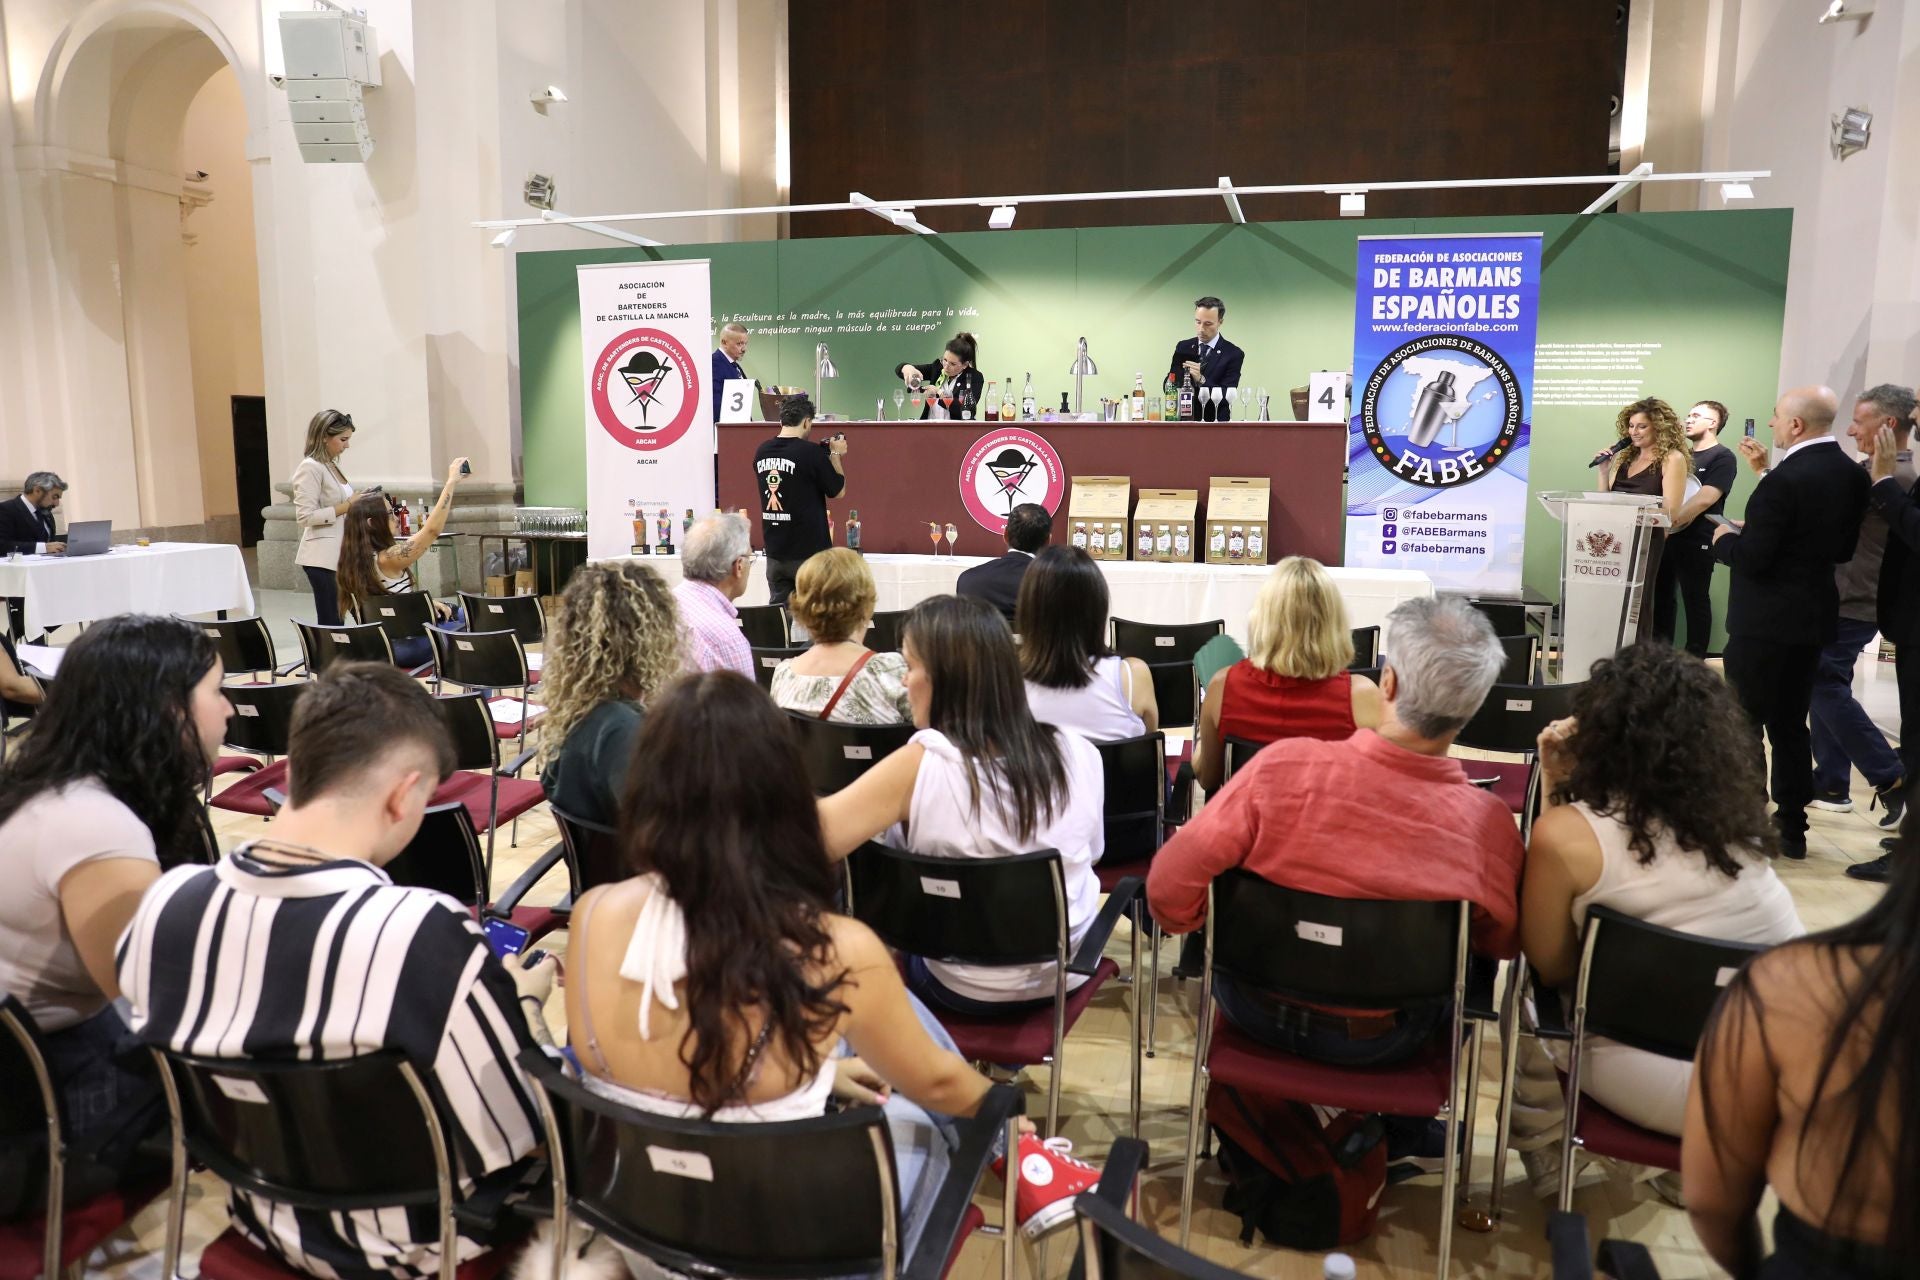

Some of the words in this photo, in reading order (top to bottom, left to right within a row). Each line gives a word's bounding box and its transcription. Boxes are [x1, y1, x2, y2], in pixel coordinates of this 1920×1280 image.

[1375, 251, 1433, 264] FEDERACIÓN
[1437, 253, 1449, 262] DE
[1452, 252, 1522, 262] ASOCIACIONES
[1373, 268, 1400, 288] DE
[1409, 267, 1522, 288] BARMANS
[618, 281, 665, 290] ASOCIACIÓN
[618, 302, 668, 310] BARTENDERS
[1372, 289, 1520, 320] ESPAÑOLES
[722, 314, 729, 322] la
[732, 313, 772, 322] Escultura
[790, 312, 797, 320] la
[801, 310, 830, 321] madre,
[836, 310, 844, 319] la
[848, 310, 865, 319] más
[870, 308, 917, 320] equilibrada
[922, 310, 942, 319] para
[946, 307, 954, 316] la
[758, 324, 800, 336] anquilosar
[837, 322, 872, 332] músculo
[876, 322, 887, 332] de
[1372, 322, 1519, 332] www.federacionfabe.com
[1365, 375, 1382, 434] FEDERACIÓN
[1378, 362, 1391, 376] DE
[1390, 338, 1458, 365] ASOCIACIONES
[1460, 340, 1473, 350] DE
[1473, 345, 1510, 382] BARMANS
[1505, 382, 1519, 436] ESPAÑOLES
[730, 392, 744, 412] 3
[1318, 386, 1336, 410] 4
[756, 458, 796, 475] CARHARTT
[1393, 449, 1484, 484] FABE
[1402, 510, 1488, 521] @fabebarmans
[1401, 526, 1487, 538] @FABEBarmans
[1400, 542, 1486, 554] @fabebarmans
[1573, 564, 1620, 577] TOLEDO
